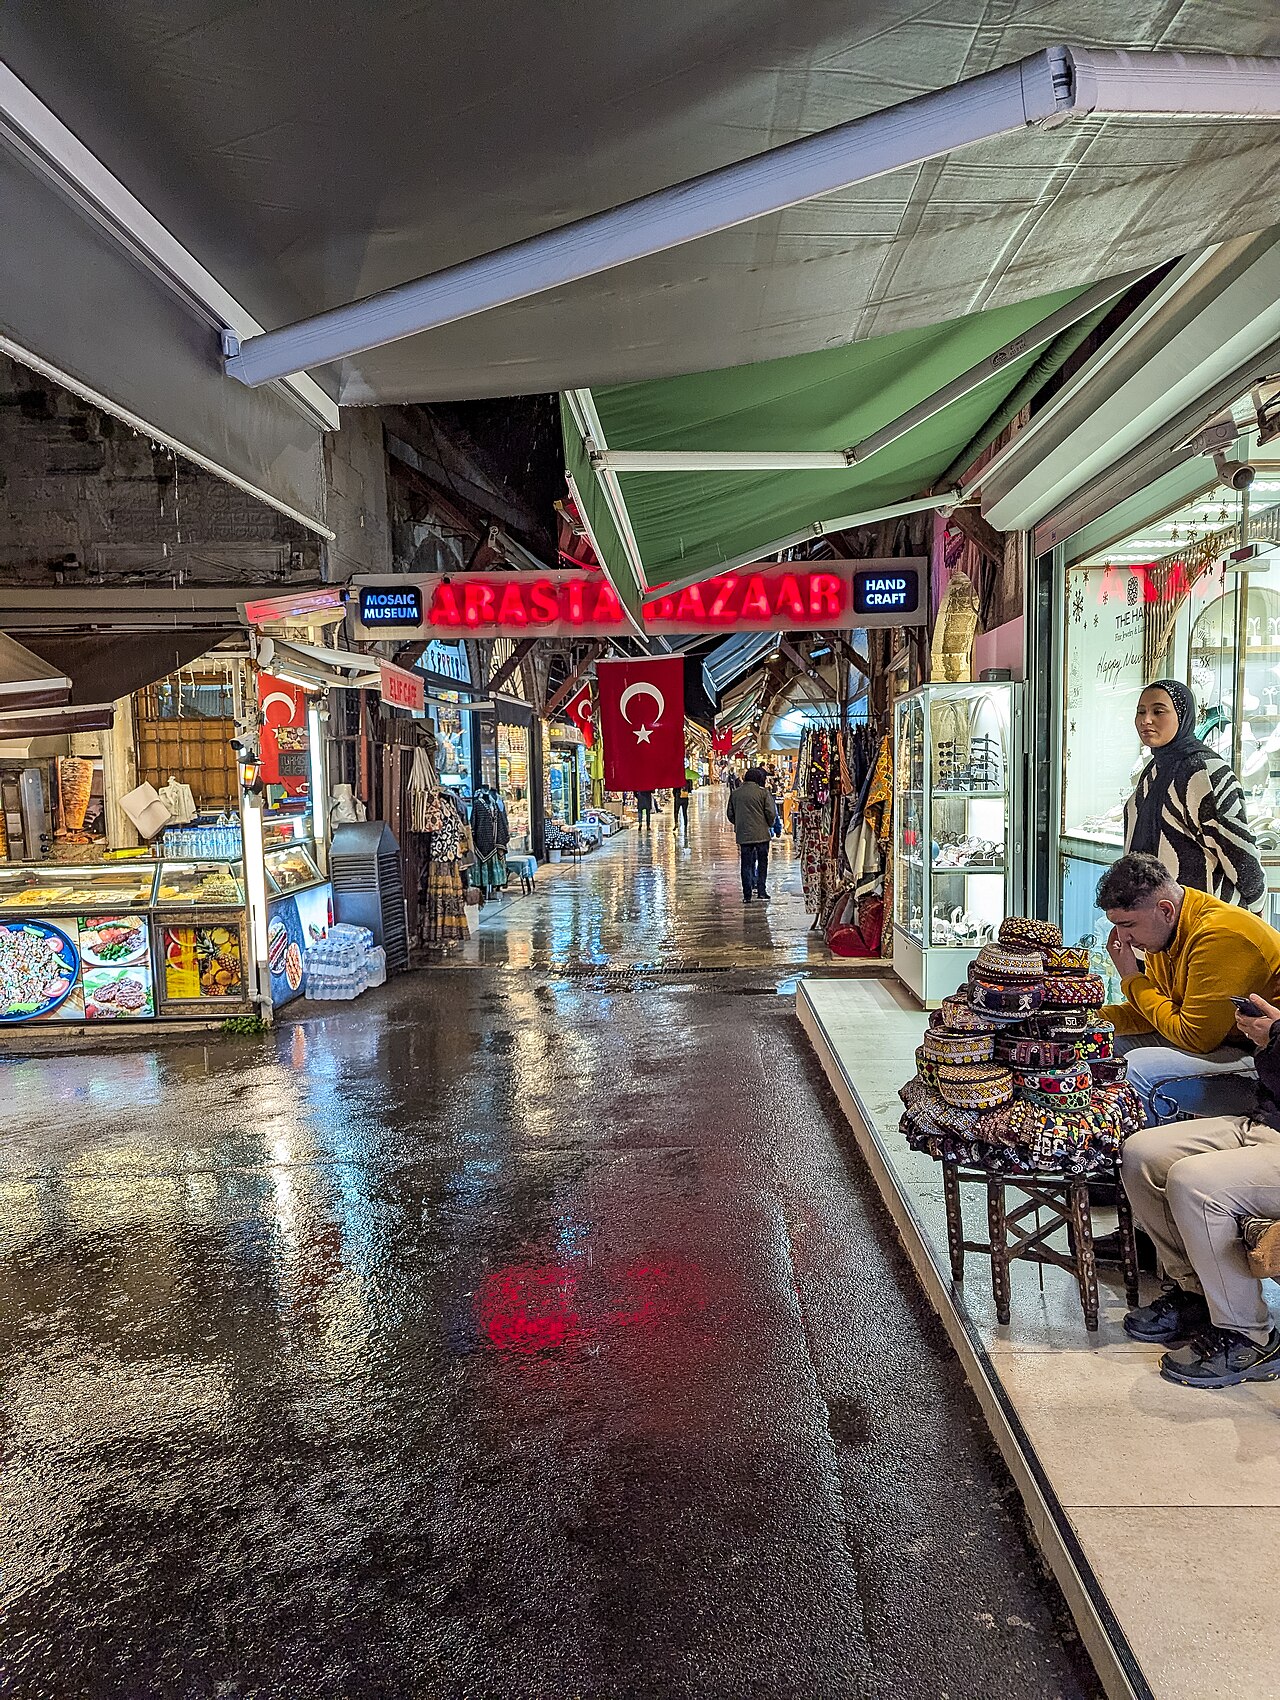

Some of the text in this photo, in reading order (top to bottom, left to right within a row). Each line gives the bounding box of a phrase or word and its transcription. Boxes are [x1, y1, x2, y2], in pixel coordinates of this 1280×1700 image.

[866, 578, 906, 590] HAND
[366, 593, 415, 606] MOSAIC
[430, 580, 625, 626] ARASTA
[866, 592, 906, 605] CRAFT
[364, 607, 418, 619] MUSEUM
[1115, 611, 1130, 629] THE
[1096, 651, 1122, 689] Happy
